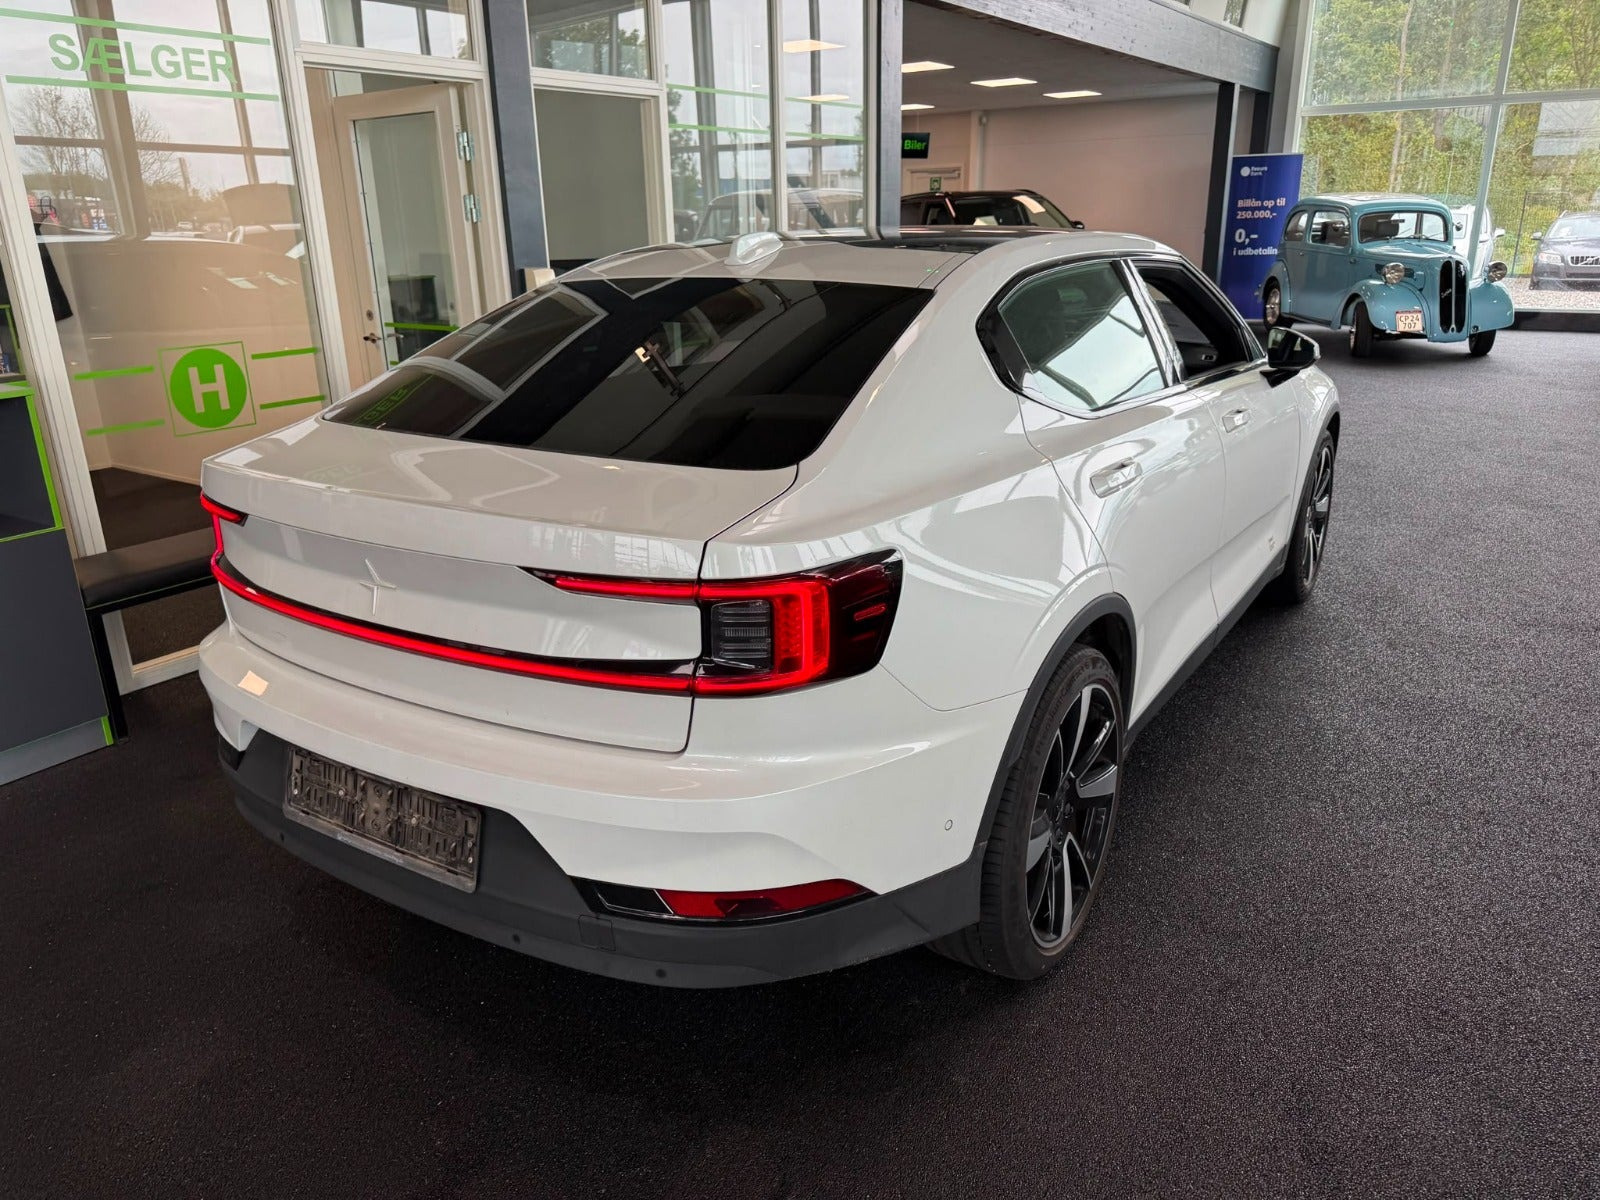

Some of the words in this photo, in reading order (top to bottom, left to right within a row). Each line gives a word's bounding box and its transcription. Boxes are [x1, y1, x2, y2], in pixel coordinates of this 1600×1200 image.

[49, 33, 237, 84] SÆLGER
[903, 139, 927, 150] Biler
[1237, 198, 1261, 207] Billån
[1276, 197, 1286, 206] til
[1236, 210, 1277, 219] 250.000,-
[1233, 247, 1237, 256] i
[1237, 246, 1278, 256] udbetalin
[1400, 314, 1420, 322] CP24
[187, 363, 231, 414] H
